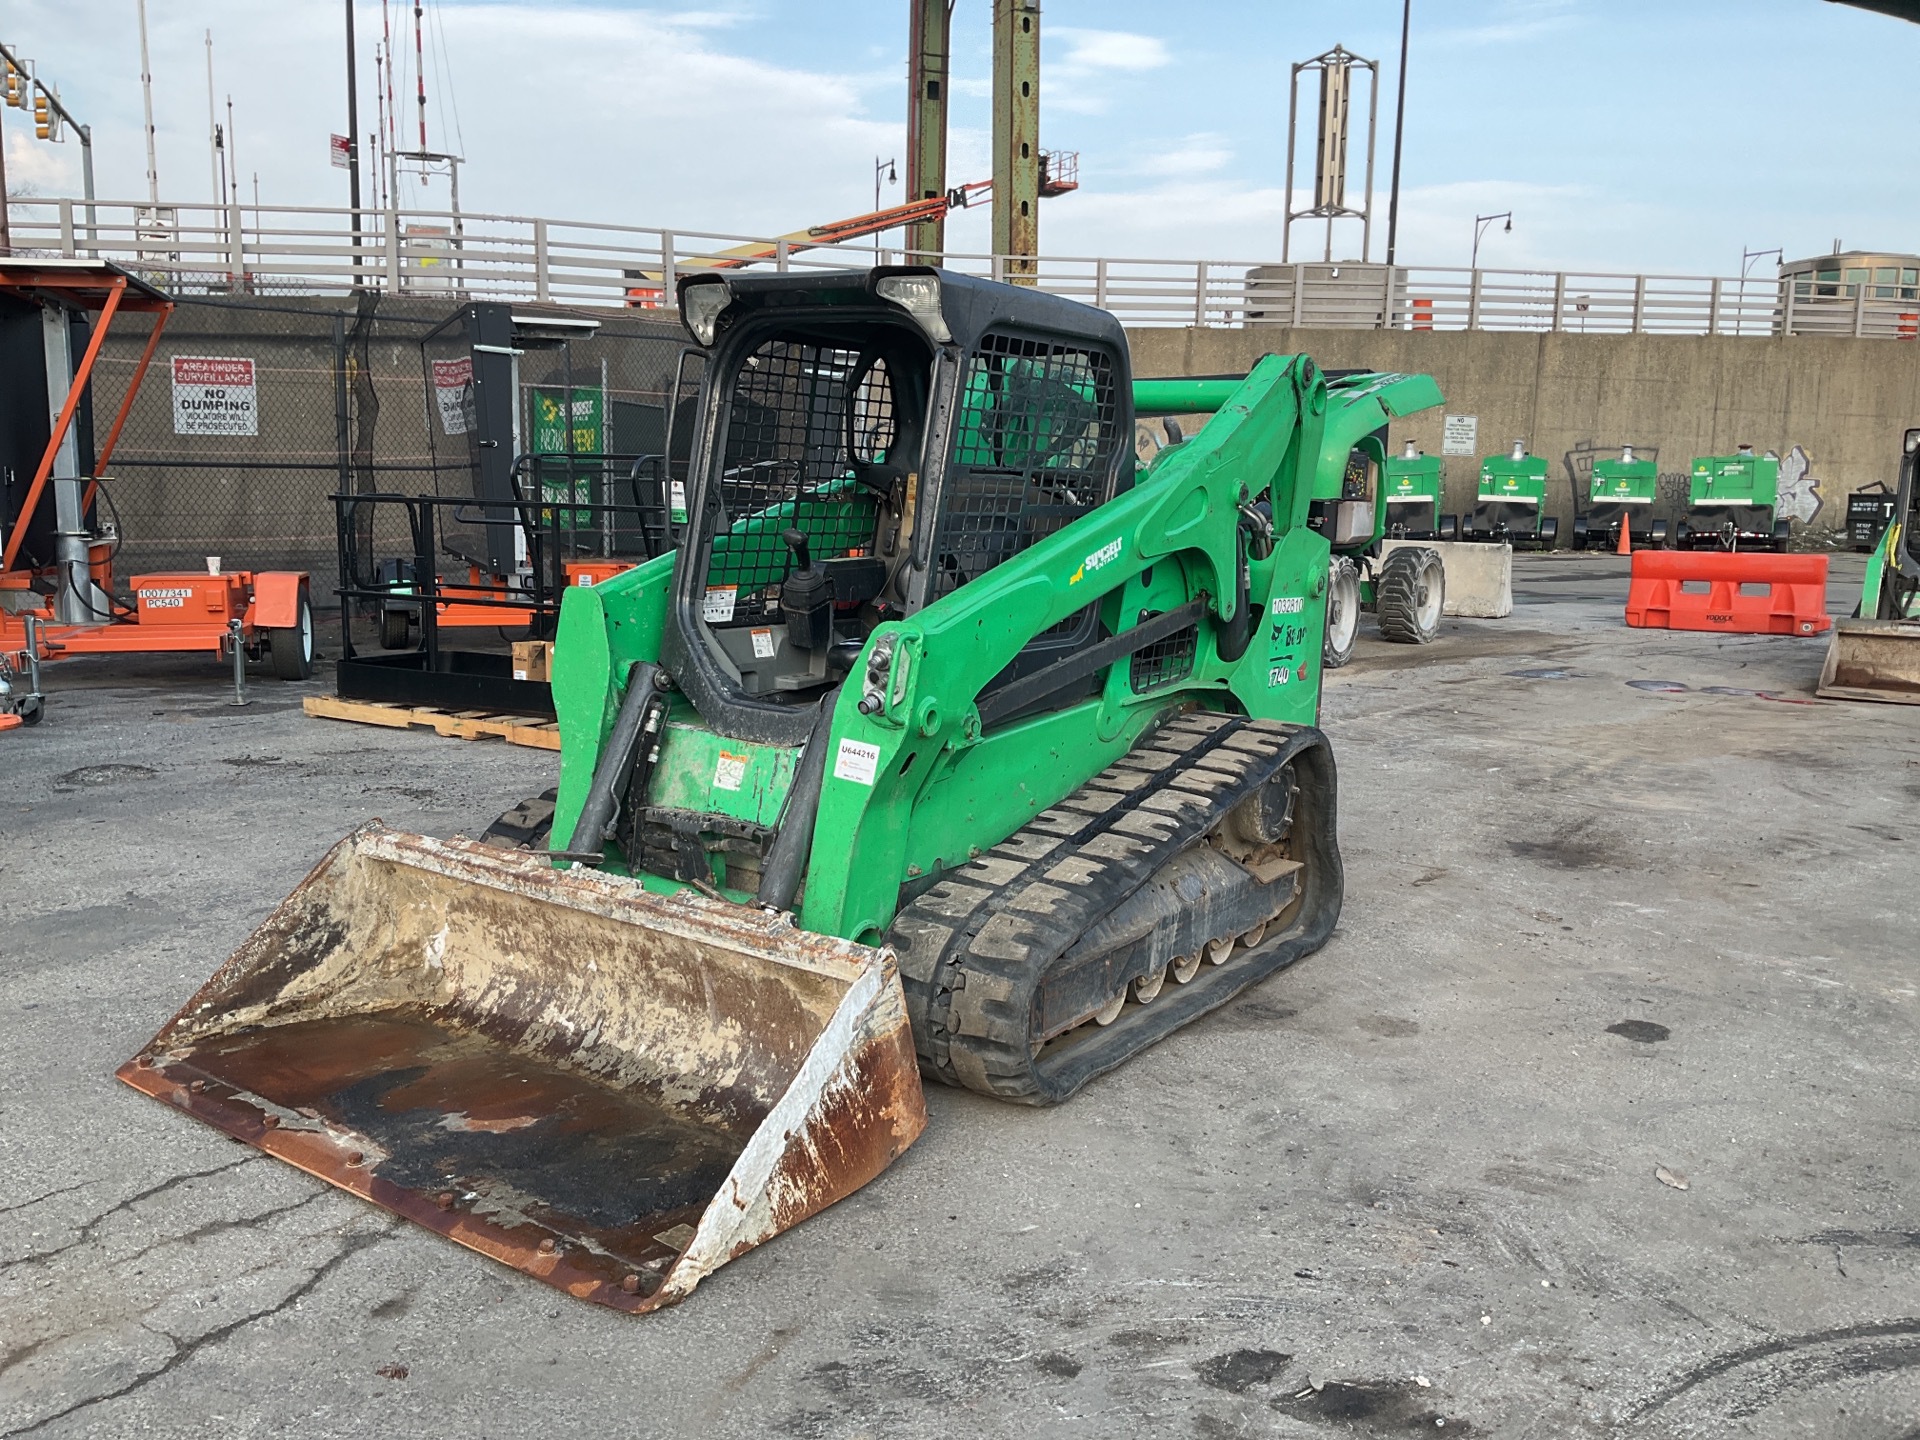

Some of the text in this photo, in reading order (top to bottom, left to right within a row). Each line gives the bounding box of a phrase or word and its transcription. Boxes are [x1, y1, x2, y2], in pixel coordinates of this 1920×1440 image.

[182, 362, 245, 373] AREA UNDER
[177, 371, 251, 383] SURVEILLANCE
[205, 389, 226, 399] NO
[181, 400, 250, 411] DUMPING
[186, 412, 247, 421] VIOLATORS WILL
[186, 422, 248, 431] BE PROSECUTED
[140, 589, 188, 597] 10077341
[148, 598, 180, 608] PC540
[1273, 598, 1304, 613] 1032810
[841, 745, 876, 760] U644216
